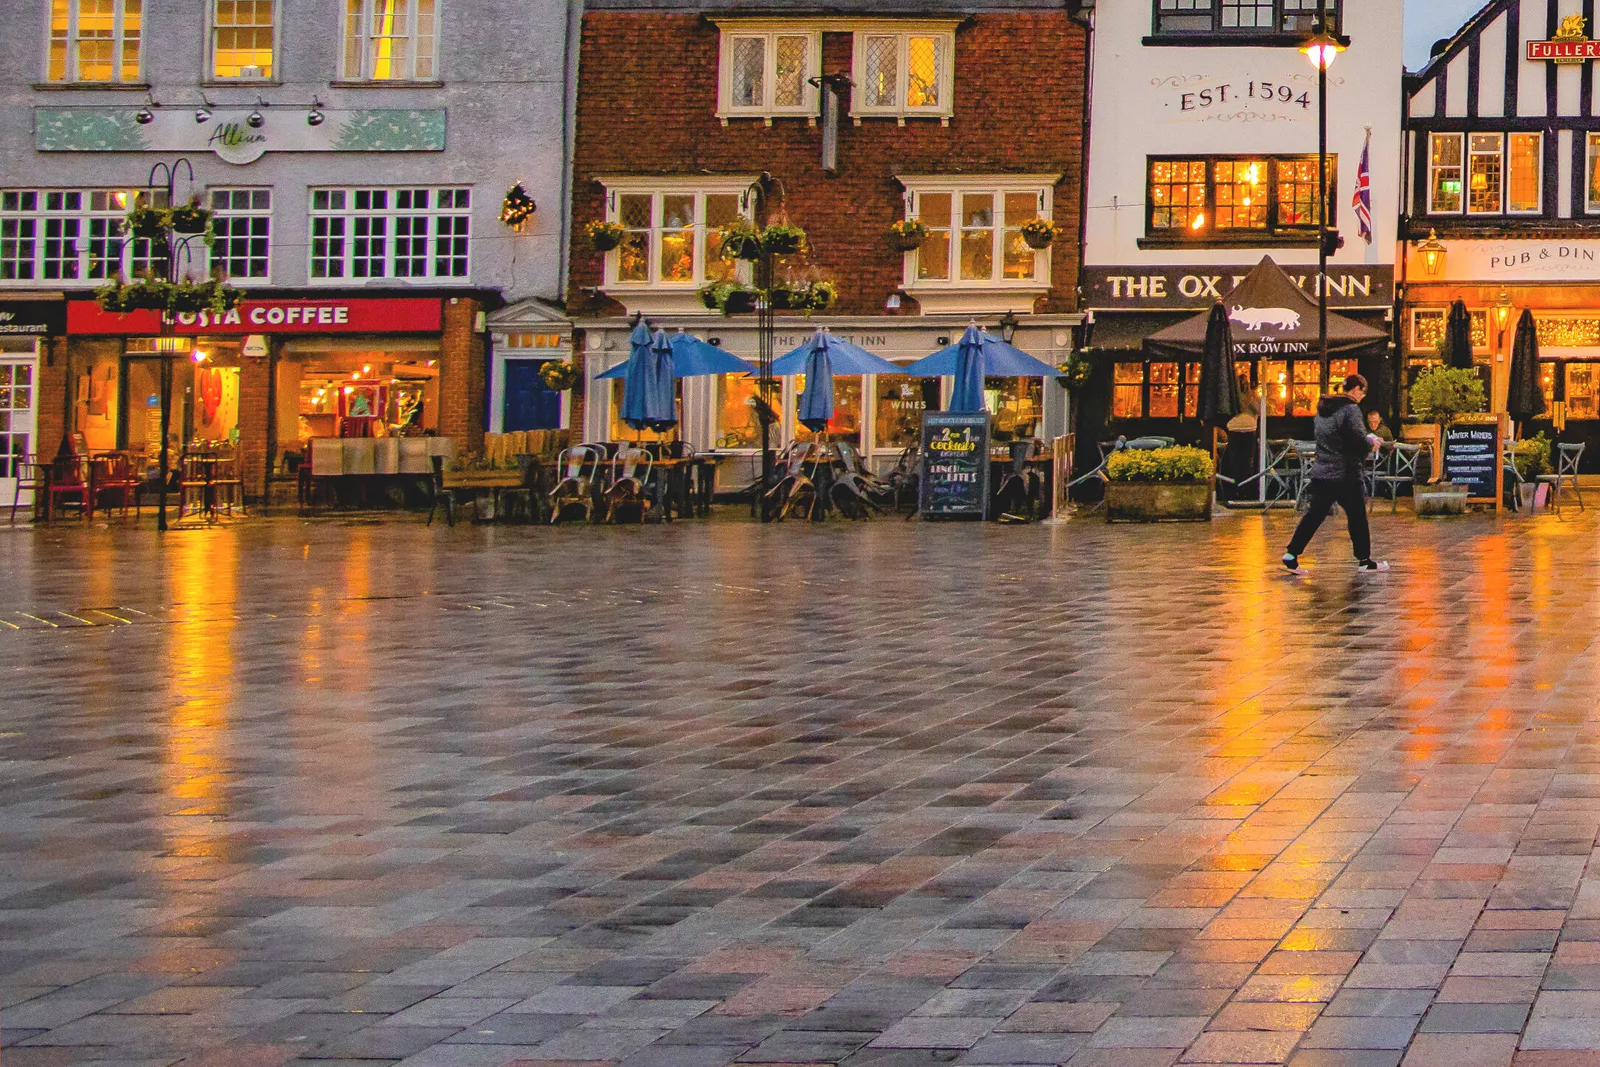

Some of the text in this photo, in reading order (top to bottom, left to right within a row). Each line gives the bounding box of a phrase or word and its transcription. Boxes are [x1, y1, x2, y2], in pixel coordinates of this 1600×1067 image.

[1180, 80, 1311, 111] EST. 1594
[1490, 252, 1531, 268] PUB
[1539, 248, 1550, 260] &
[1106, 276, 1167, 298] THE
[1178, 276, 1222, 298] OX
[1315, 275, 1371, 297] INN
[250, 307, 349, 325] COFFEE
[0, 323, 48, 333] estaurant
[861, 336, 886, 346] INN
[1250, 343, 1281, 353] ROW
[1284, 342, 1309, 353] INN
[891, 401, 927, 409] WINES
